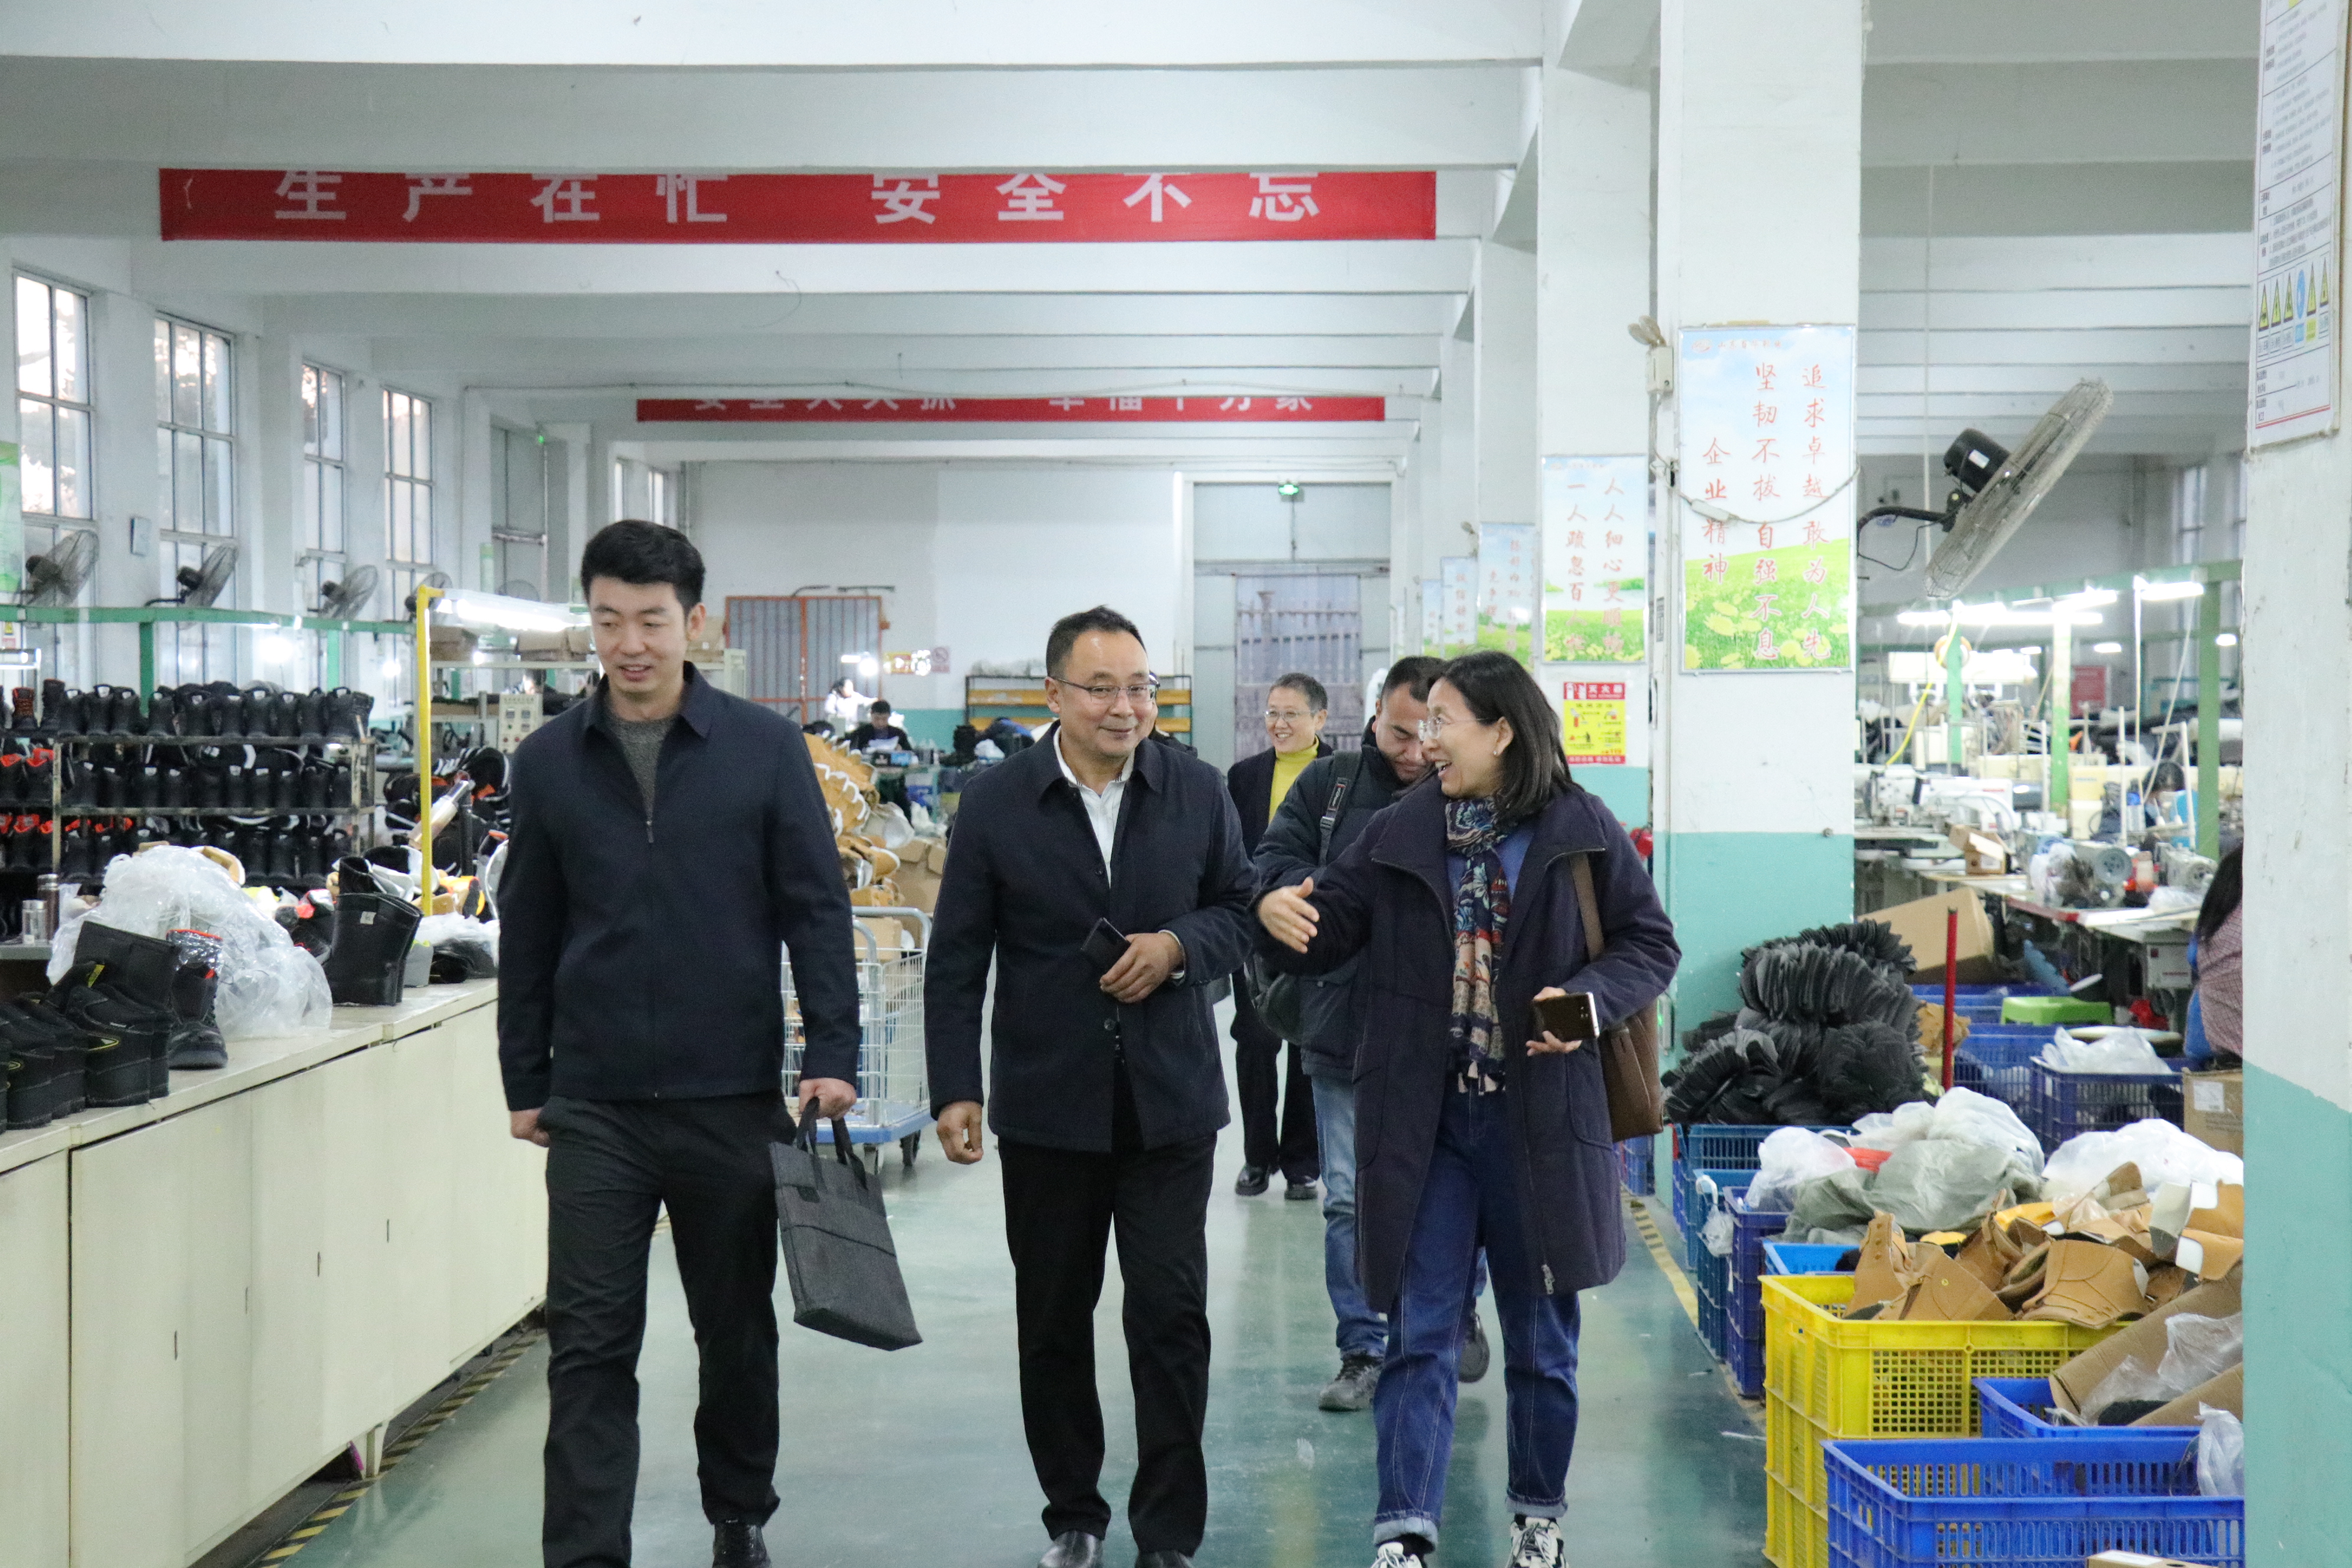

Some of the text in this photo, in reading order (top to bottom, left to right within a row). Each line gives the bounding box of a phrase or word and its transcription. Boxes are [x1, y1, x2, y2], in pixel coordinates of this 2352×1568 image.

[275, 171, 1320, 224] 生产在忙 安全不忘
[1702, 437, 1731, 584] 企业精神
